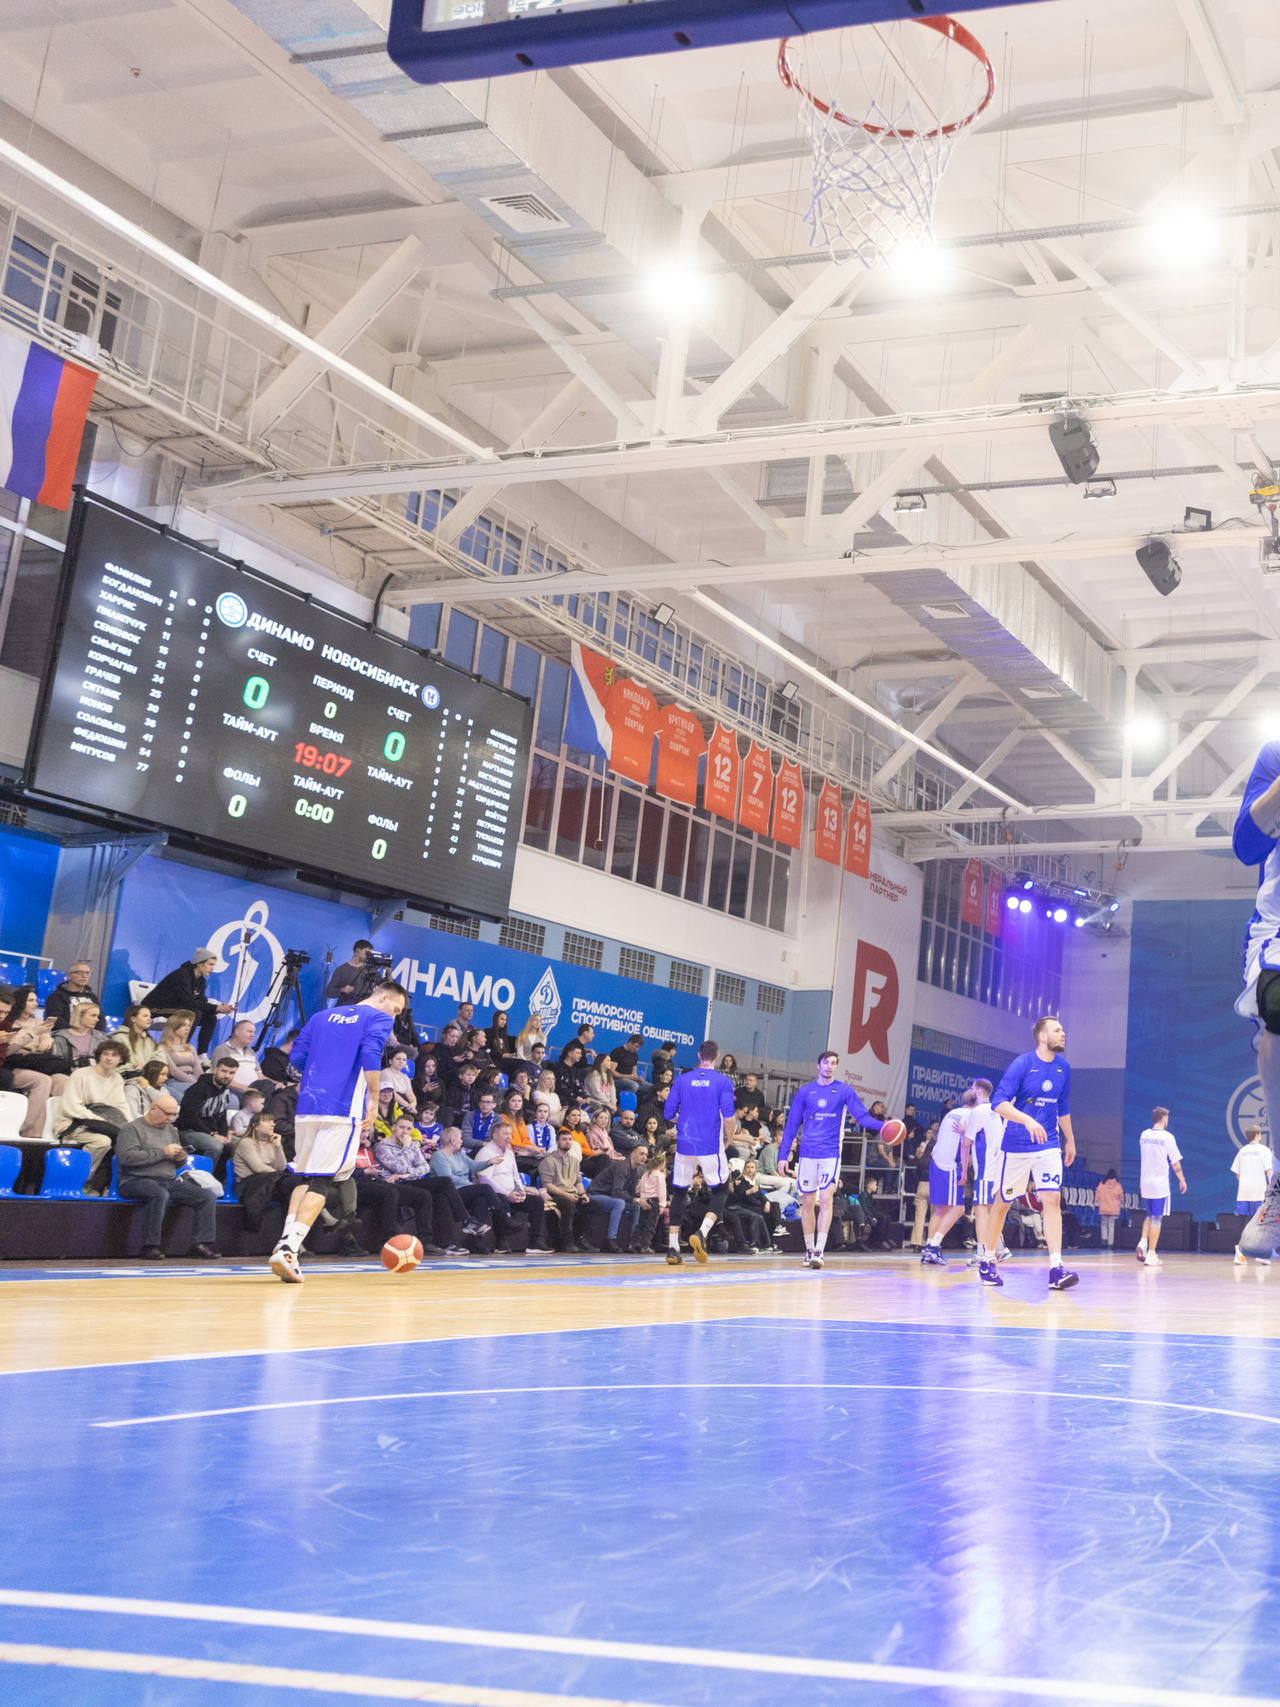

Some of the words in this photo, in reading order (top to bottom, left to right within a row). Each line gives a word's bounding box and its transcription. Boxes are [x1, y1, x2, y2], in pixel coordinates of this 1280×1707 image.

[246, 612, 315, 651] ДИНАМО
[321, 644, 420, 698] НОВОСИБИРСК
[247, 647, 278, 667] СЧЕТ
[243, 676, 270, 710] 0
[312, 674, 355, 702] ПЕРИОД
[324, 701, 337, 719] 0
[387, 705, 412, 723] СЧЕТ
[222, 712, 279, 742] ТАЙМ-АУТ
[308, 722, 345, 744] ВРЕМЯ
[384, 731, 406, 762] 0
[295, 742, 352, 777] 19:07
[714, 754, 732, 782] 12
[223, 767, 261, 788] ФОЛЫ
[293, 774, 345, 800] ТАЙМ-АУТ
[367, 765, 414, 790] ТАЙМ-АУТ
[752, 771, 763, 795] 7
[227, 794, 247, 818] 0
[294, 798, 334, 824] 0:00
[781, 787, 797, 814] 12
[367, 814, 399, 832] ФОЛЫ
[824, 807, 838, 831] 13
[853, 821, 867, 845] 14
[371, 838, 388, 860] 0
[868, 871, 908, 897] ЕНЕРАЛЬНЫЙ
[869, 883, 899, 902] ПАРТНЕР
[391, 957, 516, 1011] ИНАМО
[327, 1013, 360, 1025] ГРАЧЕВ
[572, 997, 644, 1024] ПРИМОРСКОЕ
[570, 1011, 641, 1036] СПОРТИВНОЕ
[642, 1025, 695, 1046] ОБЩЕСТВО
[1042, 1173, 1061, 1185] 54
